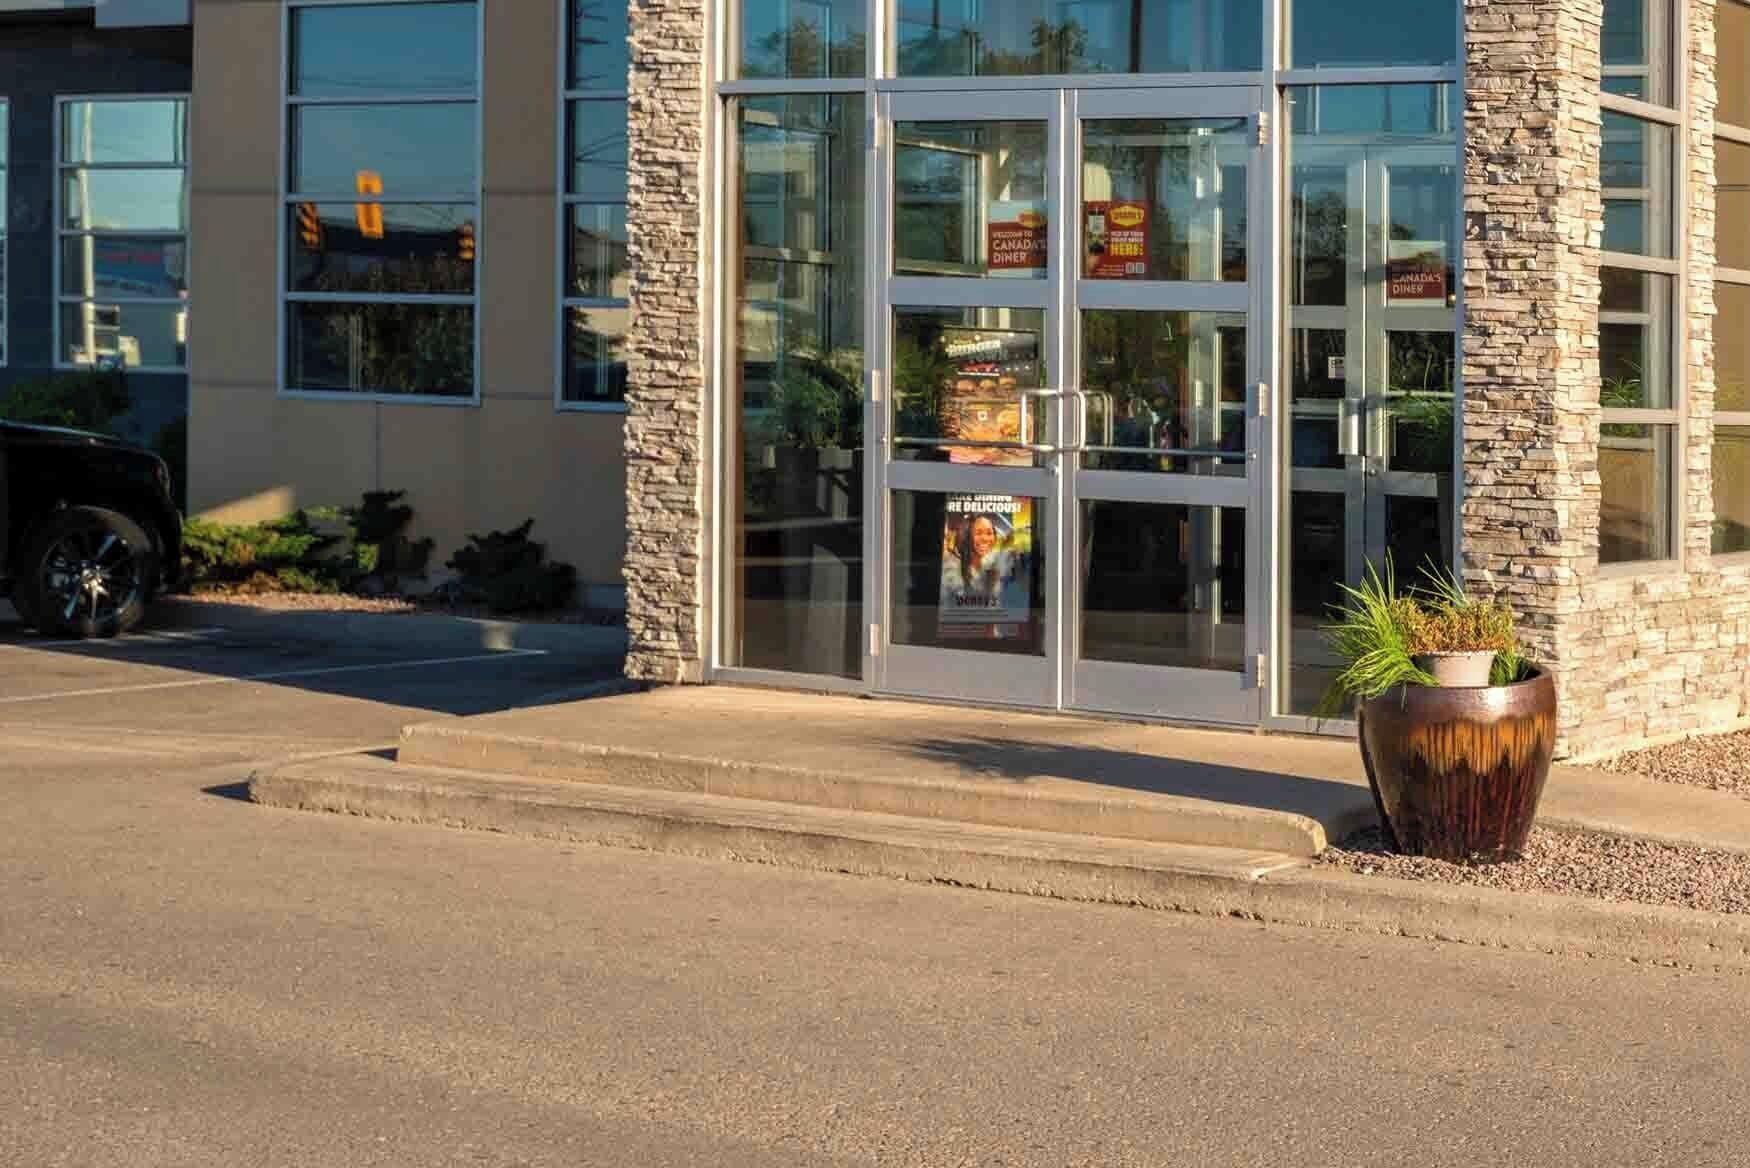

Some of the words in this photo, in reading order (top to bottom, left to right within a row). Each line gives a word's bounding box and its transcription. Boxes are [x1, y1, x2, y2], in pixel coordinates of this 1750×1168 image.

[993, 252, 1026, 264] DINER
[1392, 284, 1424, 295] DINER
[963, 502, 1022, 513] DELICIOUS!
